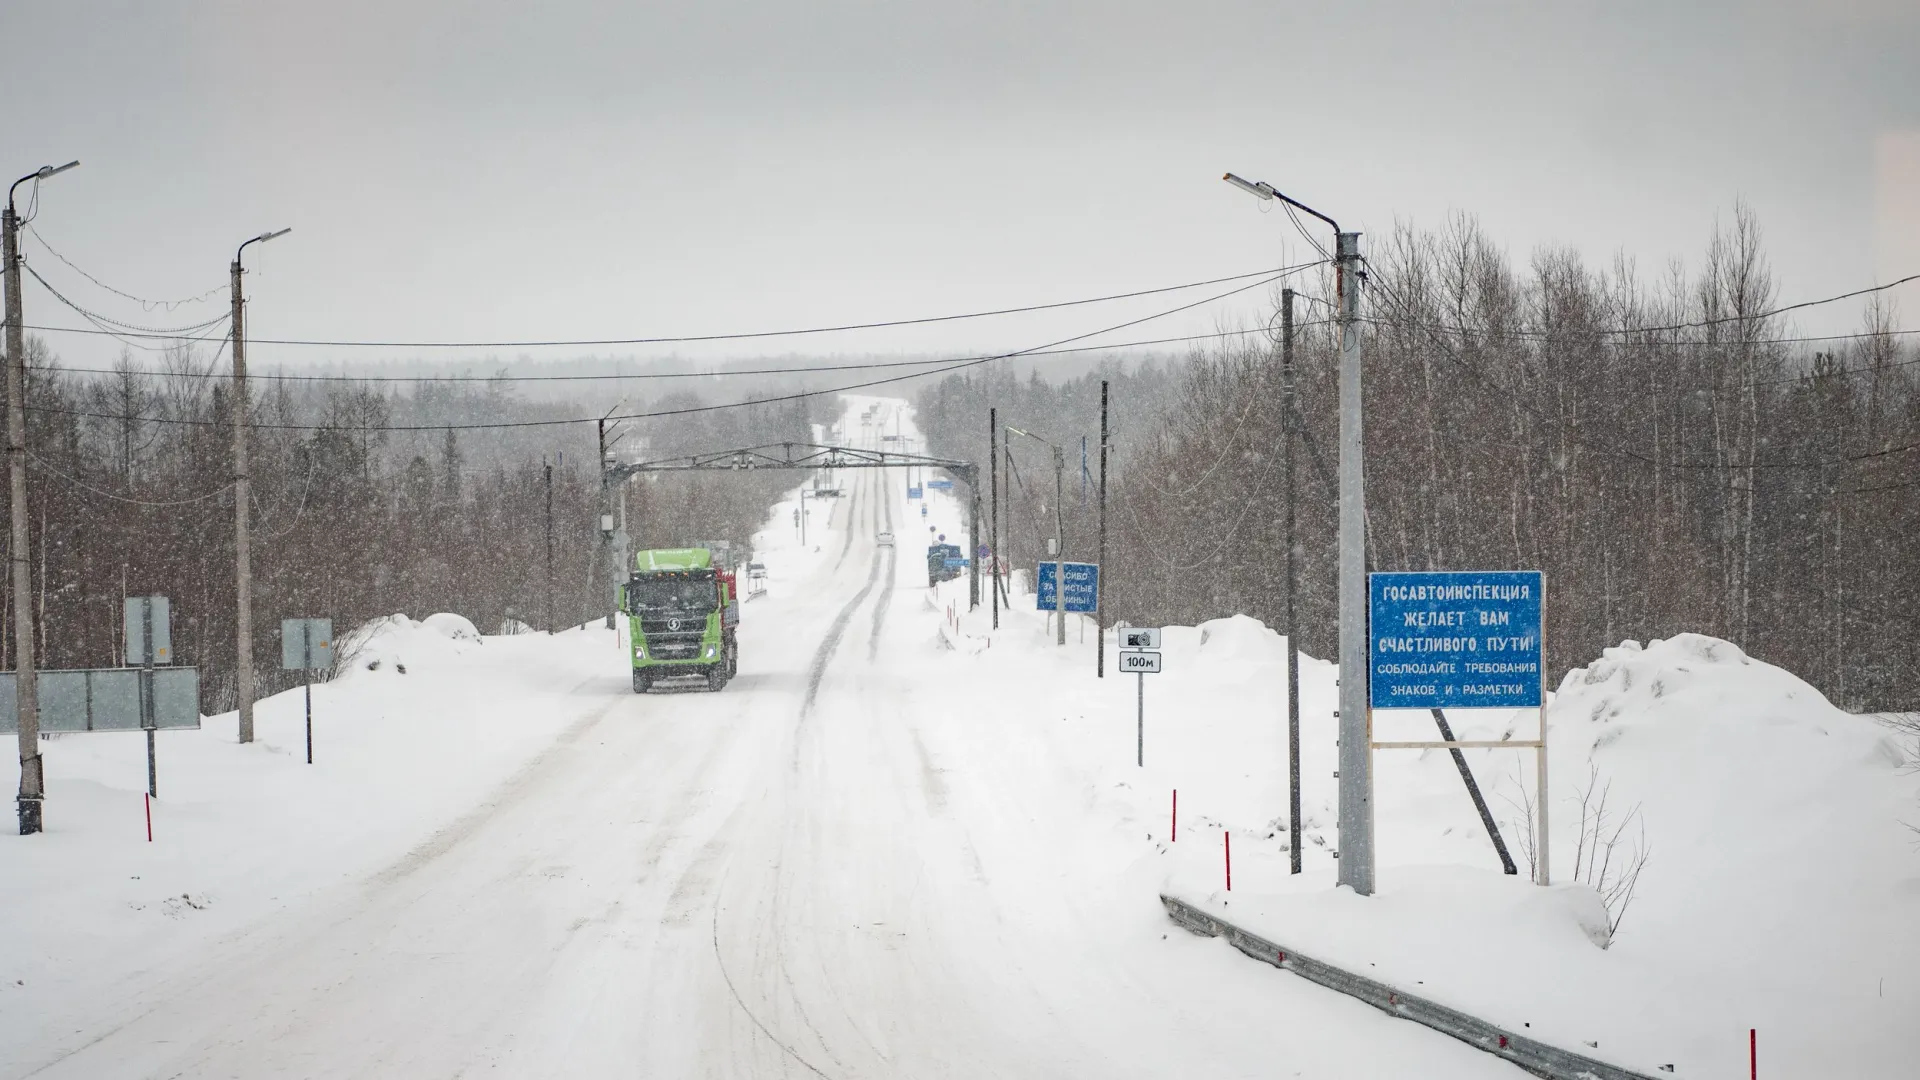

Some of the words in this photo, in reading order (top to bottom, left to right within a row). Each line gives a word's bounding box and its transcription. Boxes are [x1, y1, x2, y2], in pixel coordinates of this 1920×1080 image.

[1049, 571, 1088, 580] ССИБО
[1043, 582, 1054, 590] ЗА
[1064, 584, 1093, 593] ИСТЫЕ
[1383, 585, 1530, 601] ГОСАВТОИНСПЕКЦИЯ
[1403, 611, 1466, 627] ЖЕЛАЕТ
[1479, 611, 1509, 626] ВАМ
[1379, 637, 1477, 653] СЧАСТЛИВОГО
[1487, 636, 1534, 652] ПУТИ!
[1377, 661, 1456, 674] СОБЛЮДАЙТЕ
[1465, 662, 1537, 673] ТРЕБОВАНИЯ
[1390, 685, 1436, 696] ЗНАКОВ
[1445, 684, 1453, 695] И
